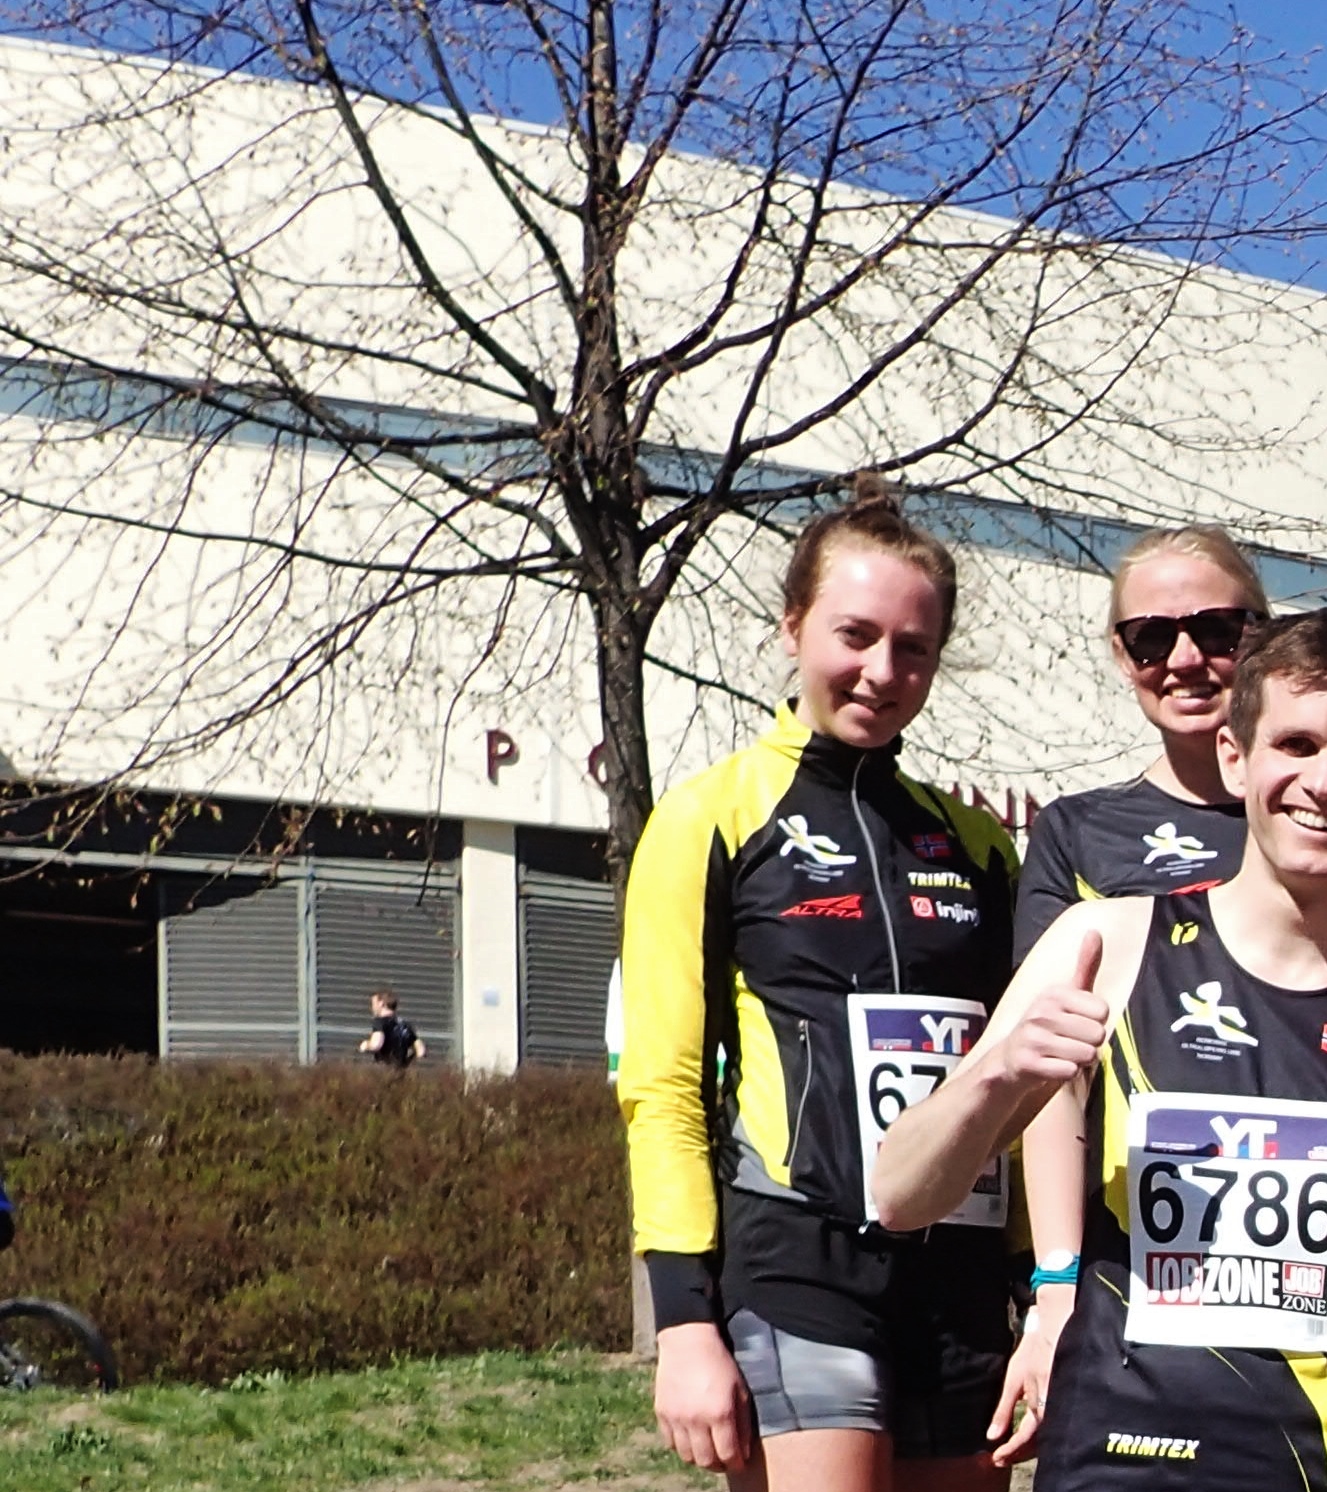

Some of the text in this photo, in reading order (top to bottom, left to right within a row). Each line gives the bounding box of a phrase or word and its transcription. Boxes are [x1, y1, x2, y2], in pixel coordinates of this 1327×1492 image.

[920, 1014, 969, 1054] YT
[1210, 1115, 1277, 1158] YT
[1282, 1294, 1327, 1315] ZONE
[1106, 1433, 1200, 1460] TRIMTEX
